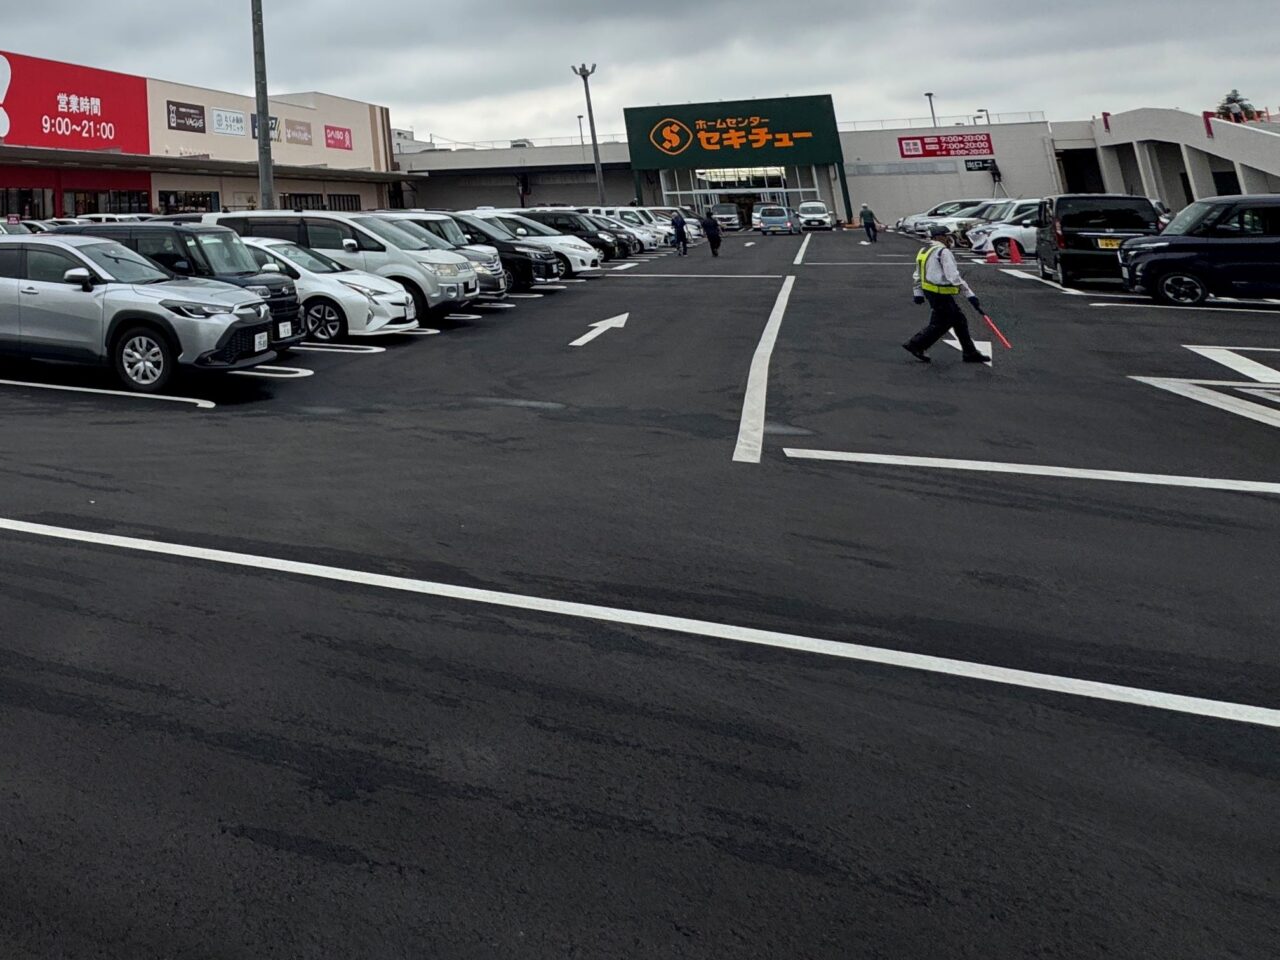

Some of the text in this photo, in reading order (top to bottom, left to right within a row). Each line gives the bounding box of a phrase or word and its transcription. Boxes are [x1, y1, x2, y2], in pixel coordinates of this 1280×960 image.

[56, 93, 102, 117] 営業時間
[695, 116, 770, 129] ホームセンター
[326, 128, 344, 140] DAISO
[696, 127, 813, 151] セキチュー
